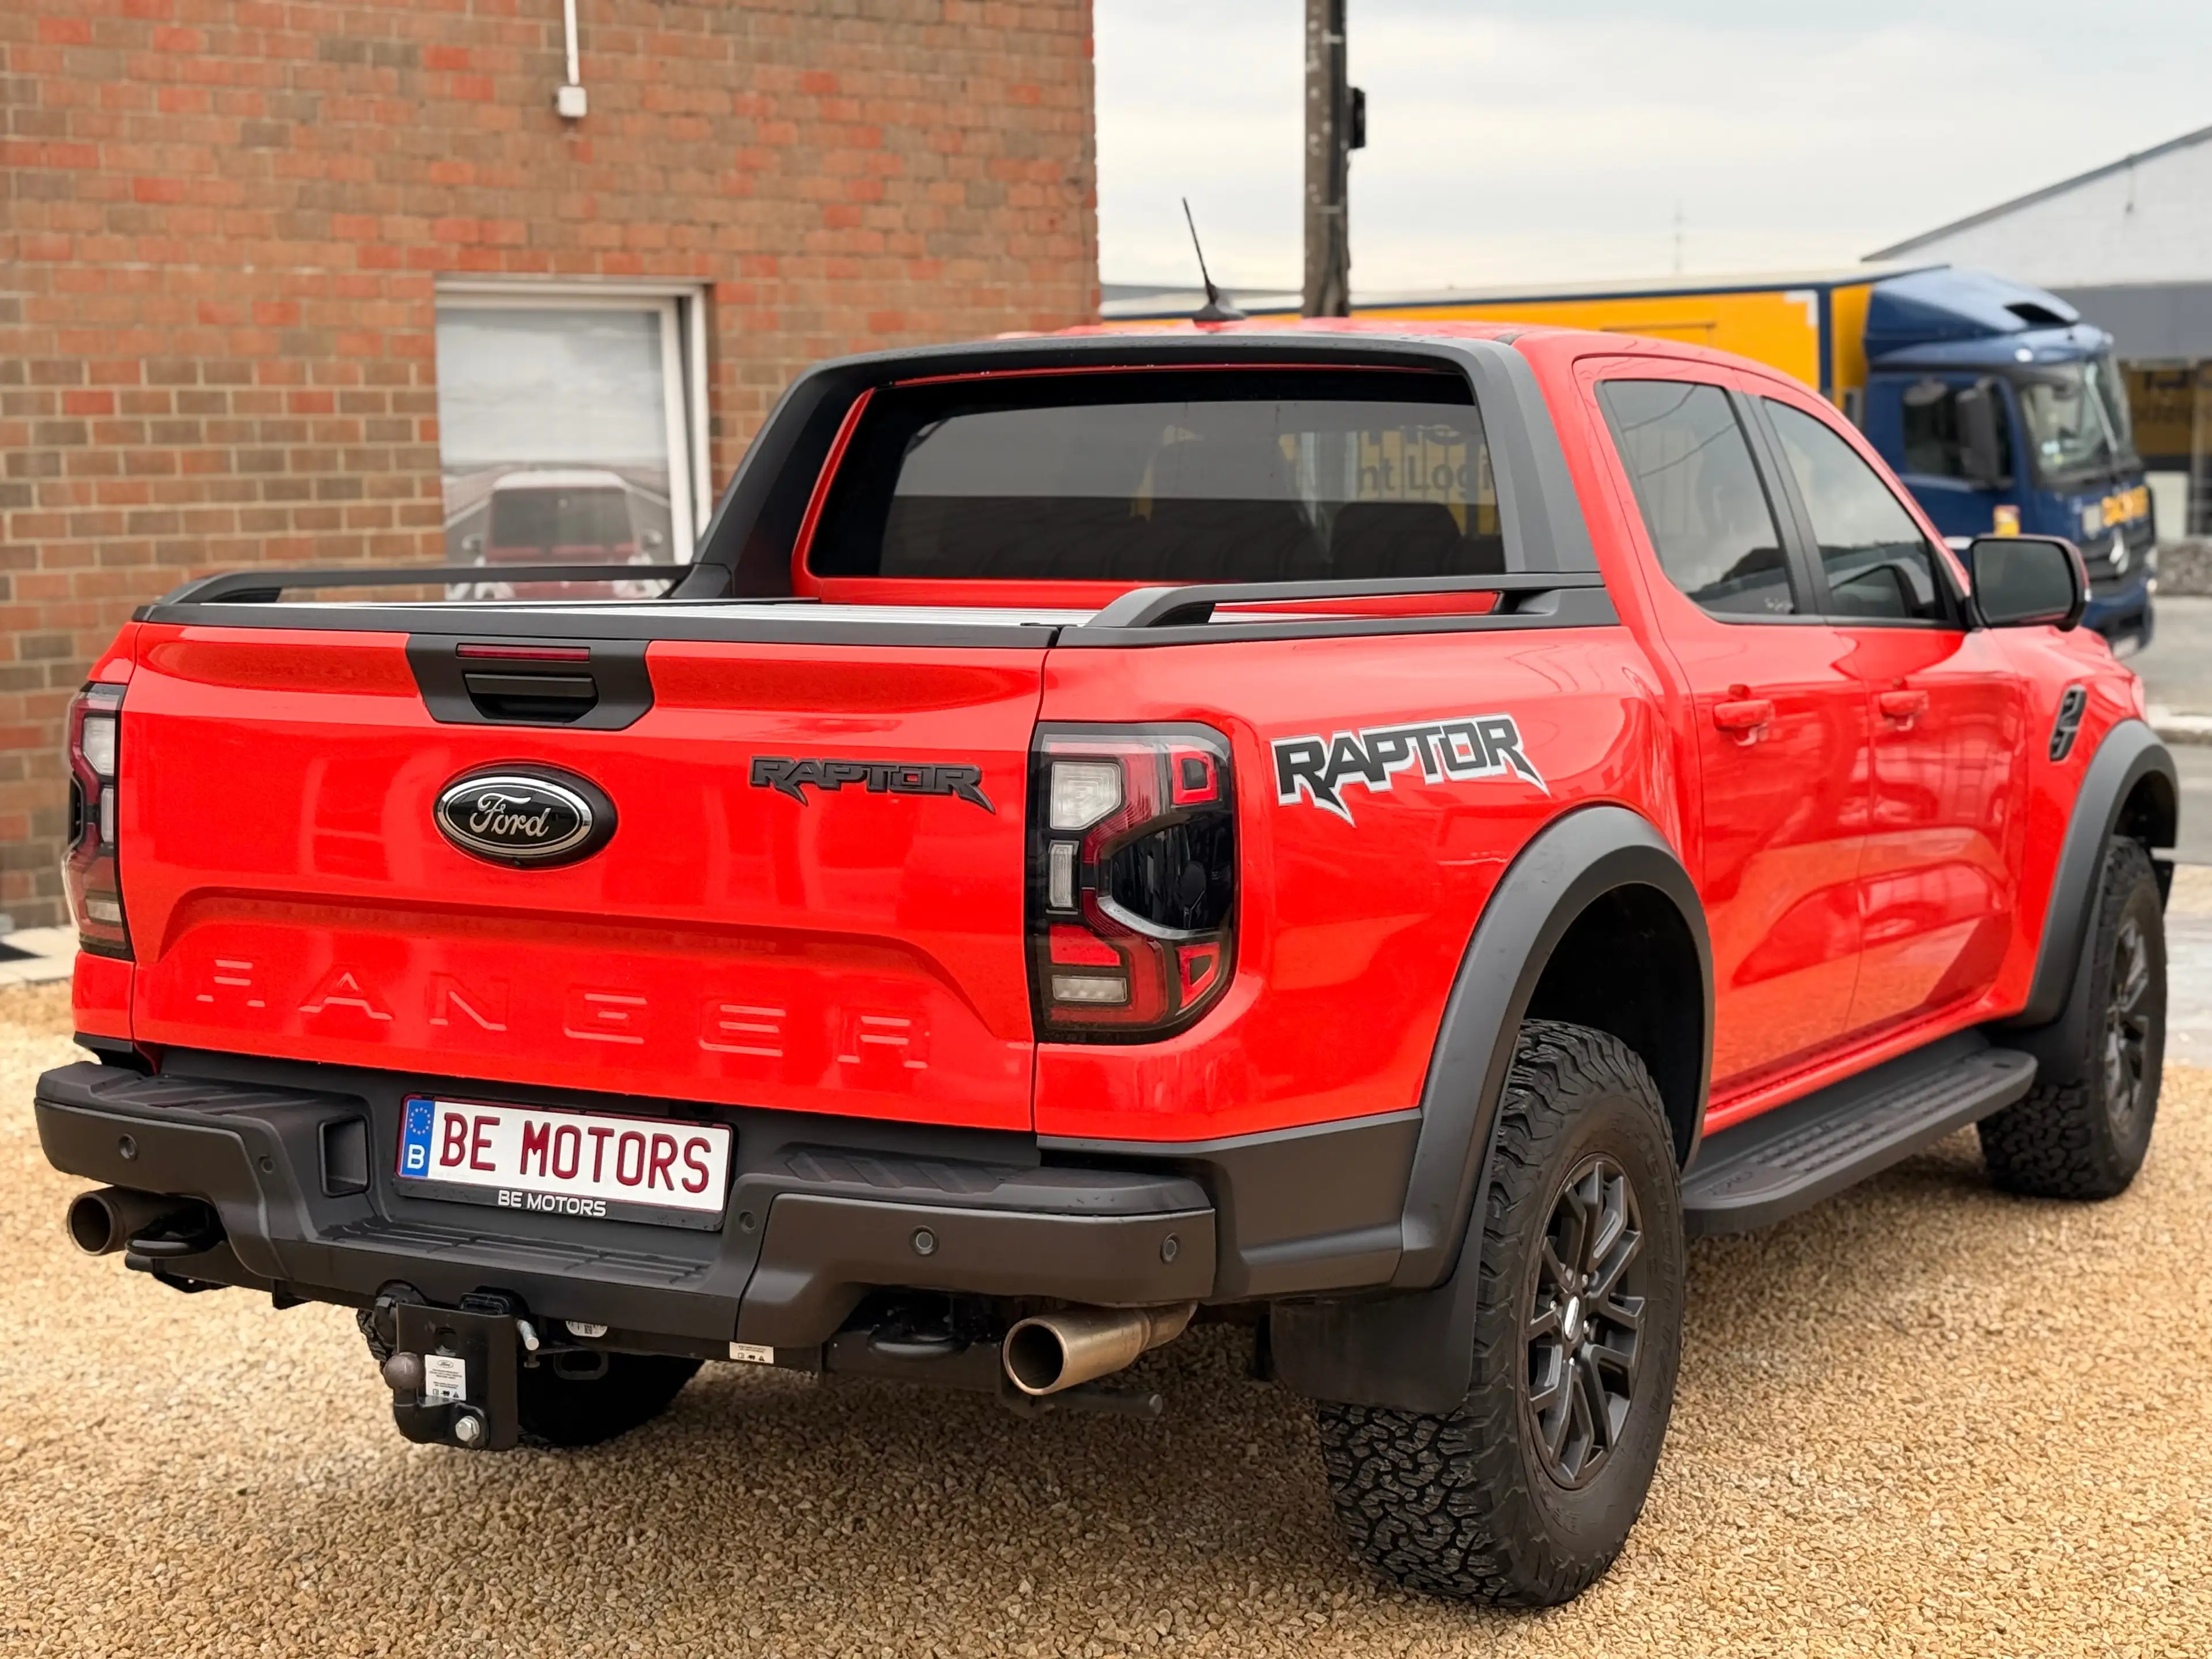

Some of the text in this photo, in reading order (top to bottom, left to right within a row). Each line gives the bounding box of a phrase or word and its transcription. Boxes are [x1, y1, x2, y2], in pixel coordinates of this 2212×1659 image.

[750, 756, 996, 815] RAPTOR
[1271, 713, 1552, 828] RAPTOR
[469, 793, 551, 838] Ford
[195, 955, 929, 1069] RANGER
[407, 1144, 425, 1169] B
[440, 1112, 711, 1193] BE MOTORS
[498, 1190, 607, 1217] BE MOTORS
